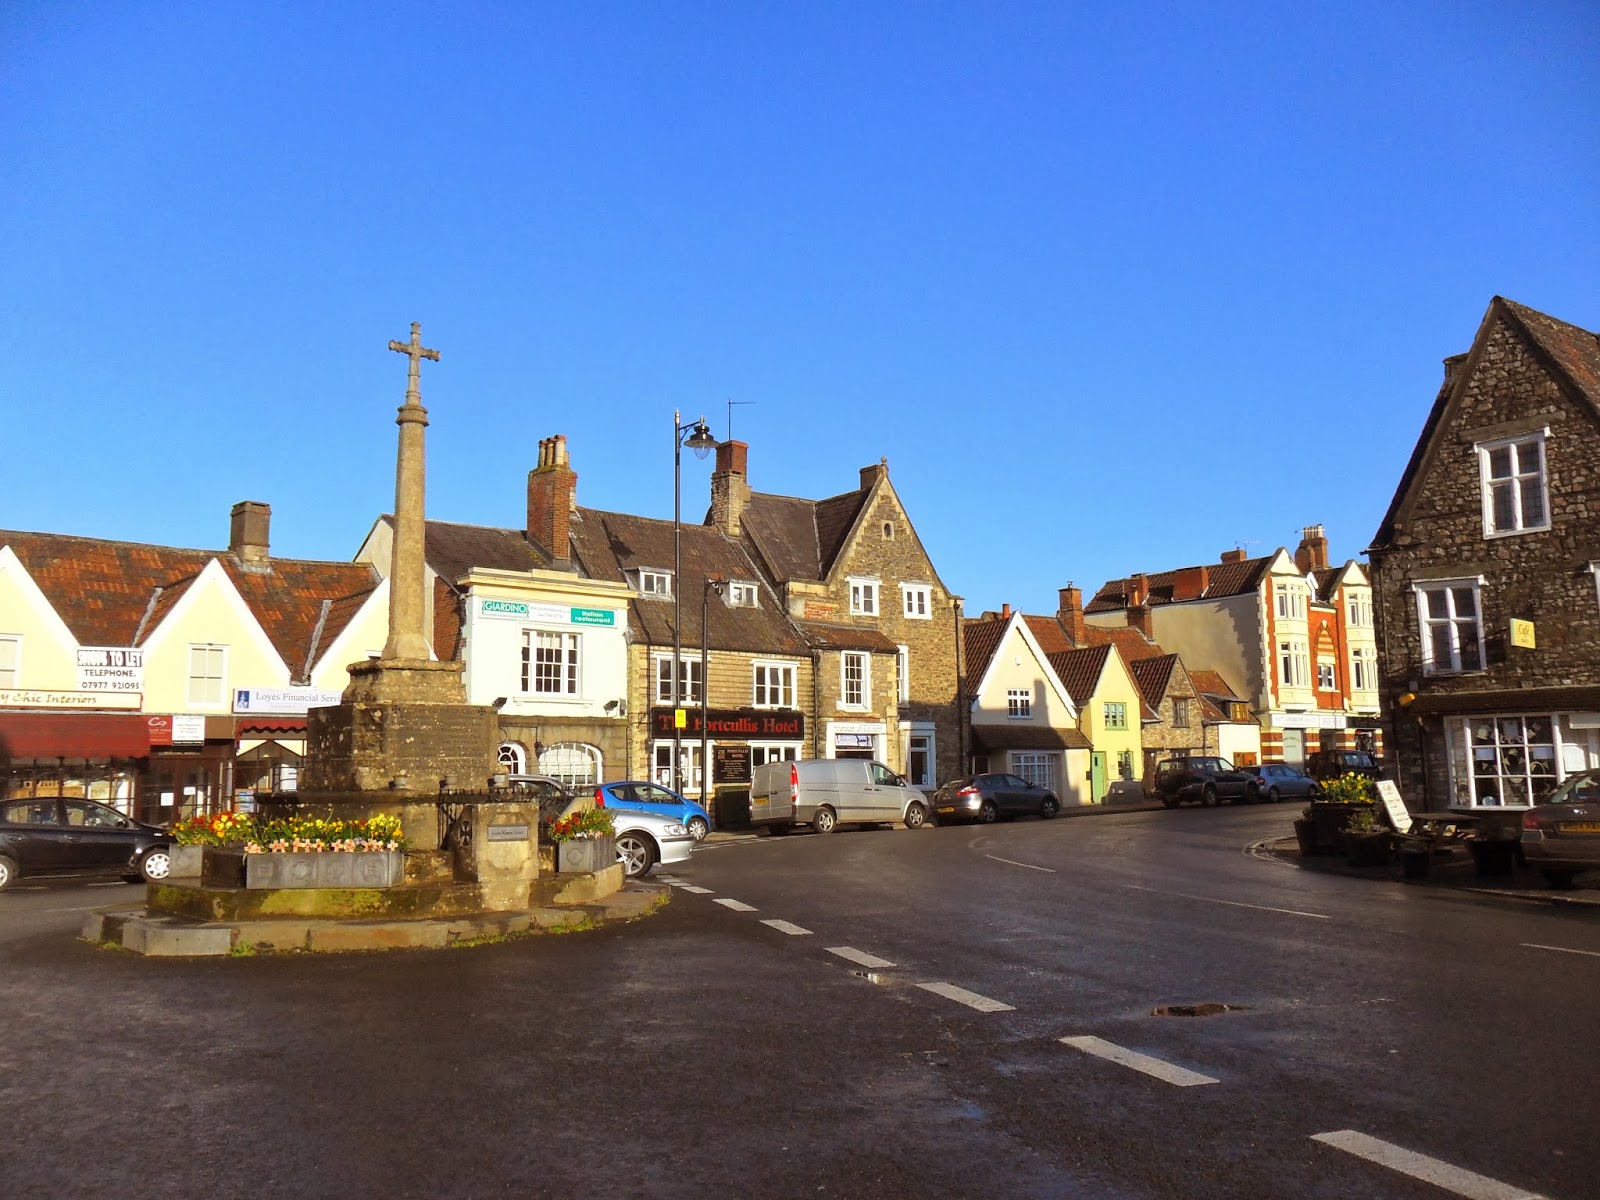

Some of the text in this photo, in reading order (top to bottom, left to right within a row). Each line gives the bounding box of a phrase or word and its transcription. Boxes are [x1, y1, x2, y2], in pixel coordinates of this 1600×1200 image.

[485, 601, 527, 613] GIARDINO
[110, 651, 124, 666] TO
[126, 652, 141, 667] LET
[112, 682, 140, 690] 921095
[12, 692, 41, 703] Chic
[45, 694, 97, 704] Interiors
[256, 692, 280, 702] Loyes
[282, 693, 318, 702] Financial
[763, 718, 800, 733] Hotel
